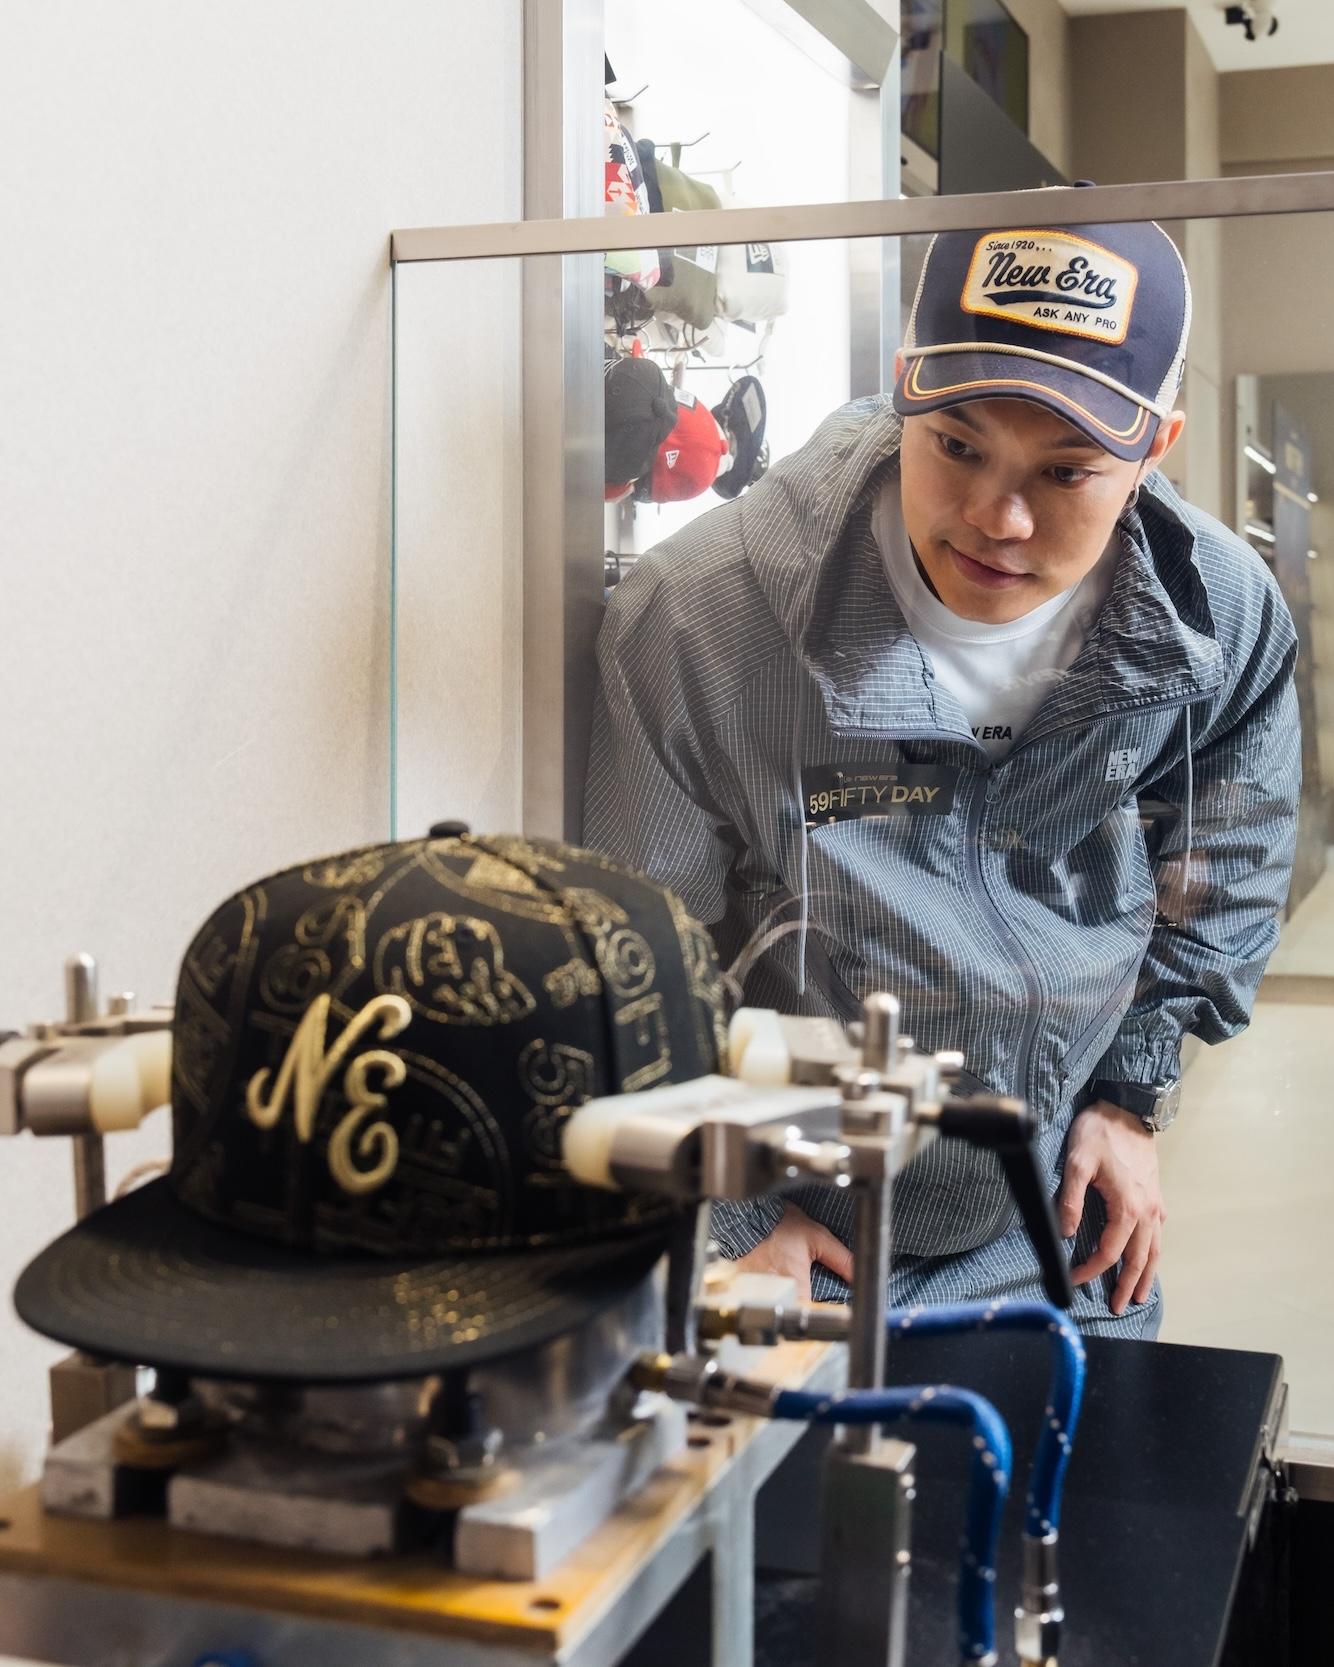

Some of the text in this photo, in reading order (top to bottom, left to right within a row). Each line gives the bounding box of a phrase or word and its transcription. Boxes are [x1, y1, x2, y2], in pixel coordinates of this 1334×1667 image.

[986, 240, 1009, 251] Since
[982, 252, 1117, 299] New Era
[1033, 307, 1117, 330] ASK ANY PRO
[982, 726, 1012, 740] ERA
[1107, 747, 1141, 766] NEW
[1105, 763, 1136, 781] ERA
[809, 785, 940, 815] 59FIFTY DAY
